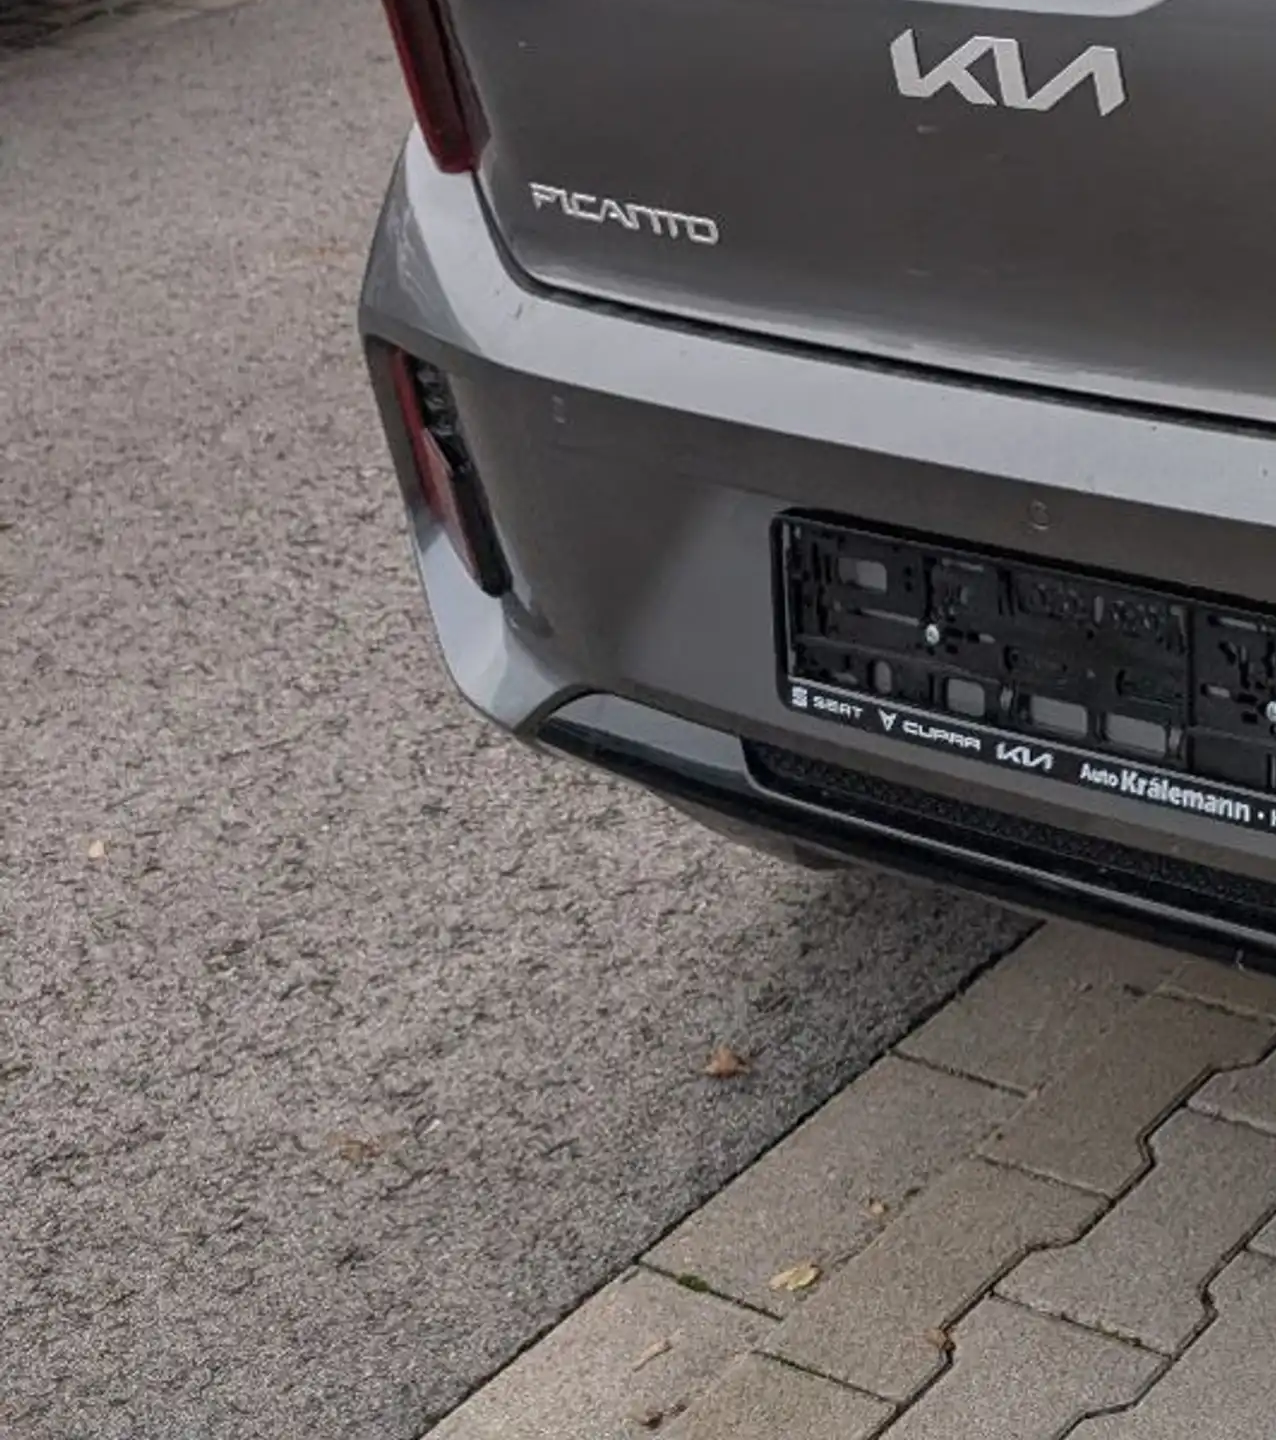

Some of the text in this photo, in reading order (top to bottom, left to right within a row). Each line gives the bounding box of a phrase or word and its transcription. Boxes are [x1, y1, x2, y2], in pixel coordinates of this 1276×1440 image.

[890, 28, 1126, 116] KIA
[528, 182, 719, 245] PICANTO
[813, 695, 863, 719] SEAT
[903, 720, 982, 751] CUPRA
[996, 742, 1054, 771] KIA
[1080, 763, 1118, 788] Auto
